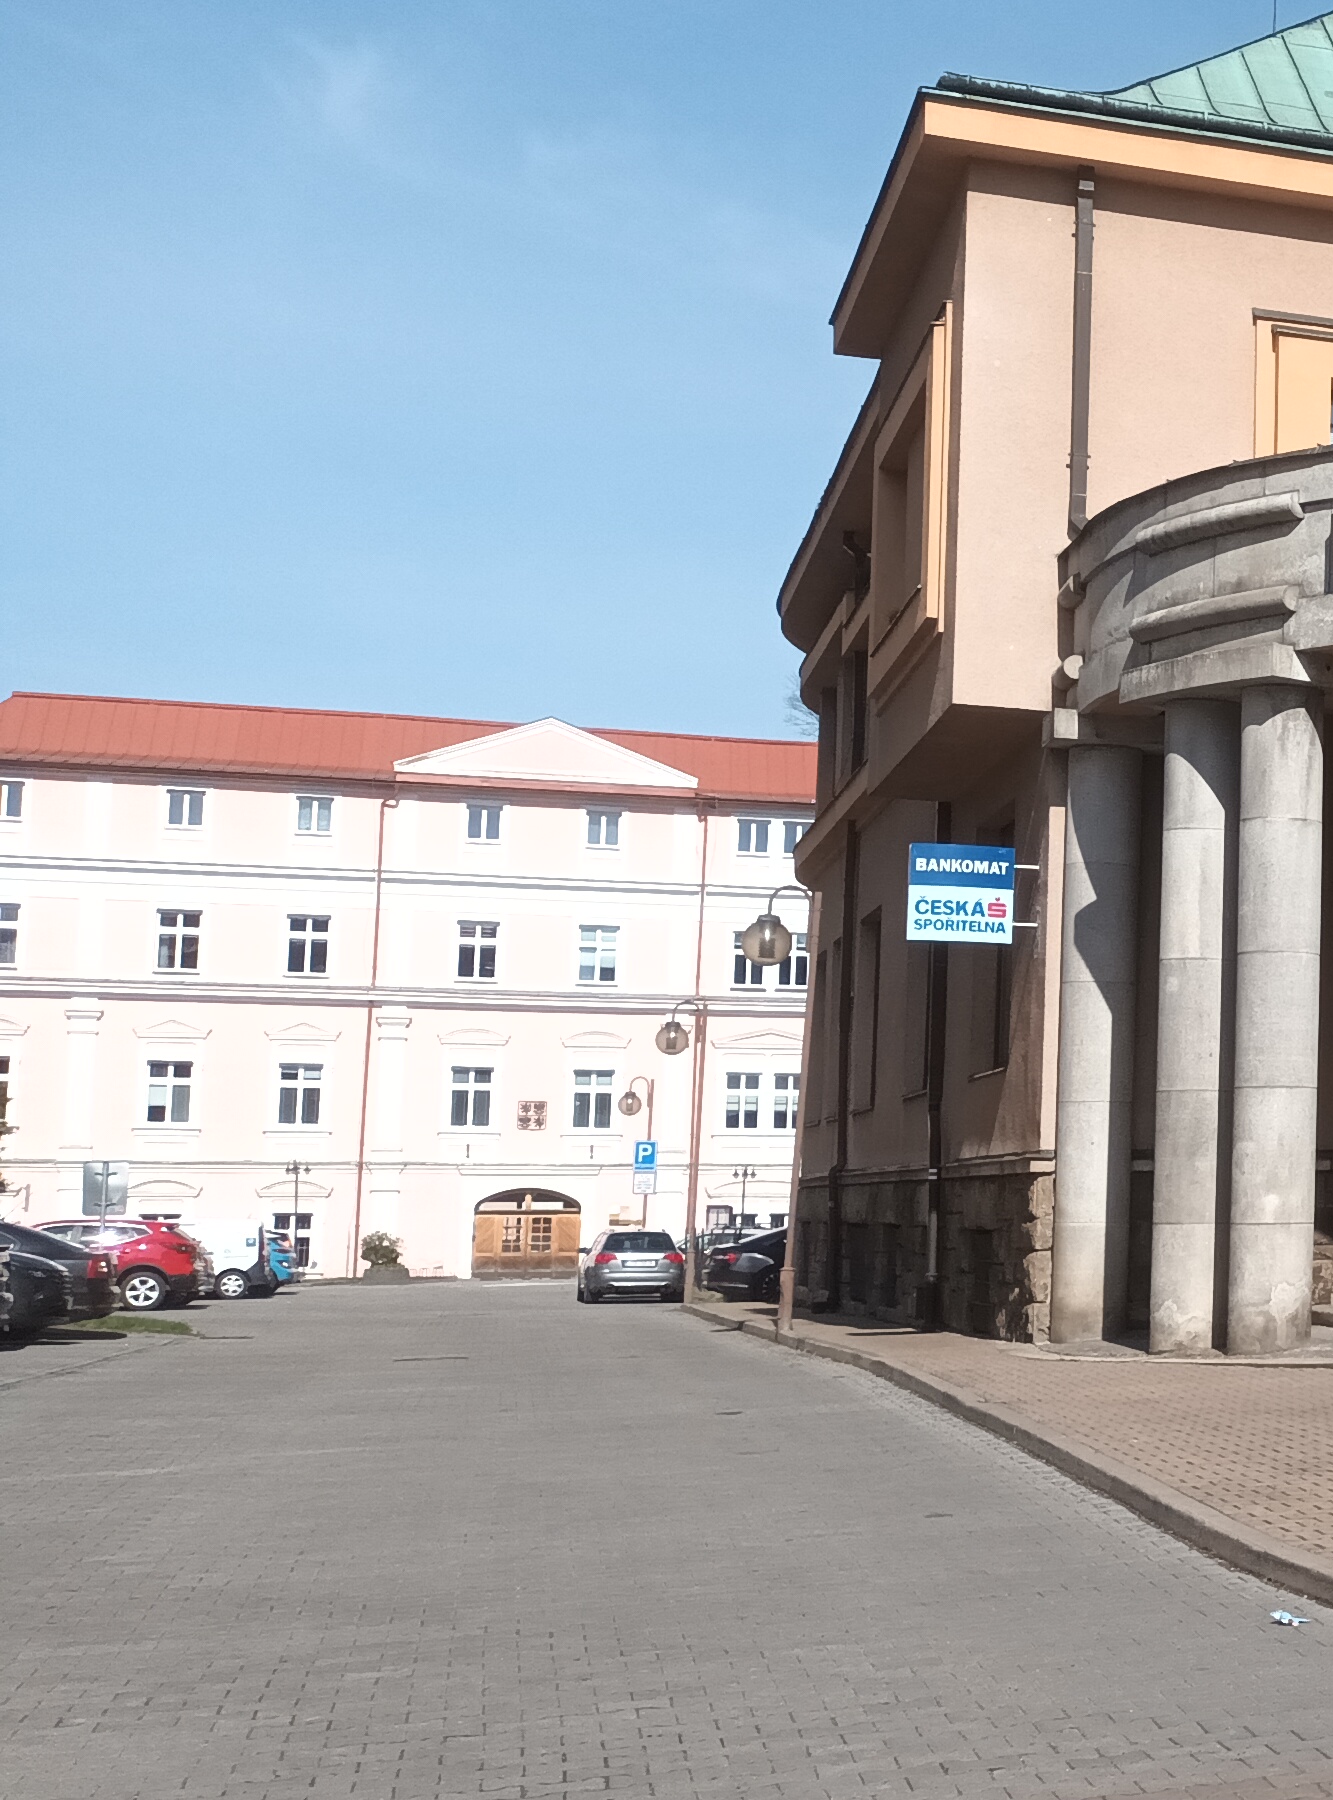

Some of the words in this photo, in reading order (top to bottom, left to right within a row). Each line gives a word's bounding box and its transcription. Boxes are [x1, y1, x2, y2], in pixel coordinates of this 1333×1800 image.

[915, 857, 1010, 876] BANKOMAT
[914, 896, 986, 918] ČESKÁ
[913, 917, 1006, 934] SPOŘITELNA
[637, 1144, 653, 1163] P
